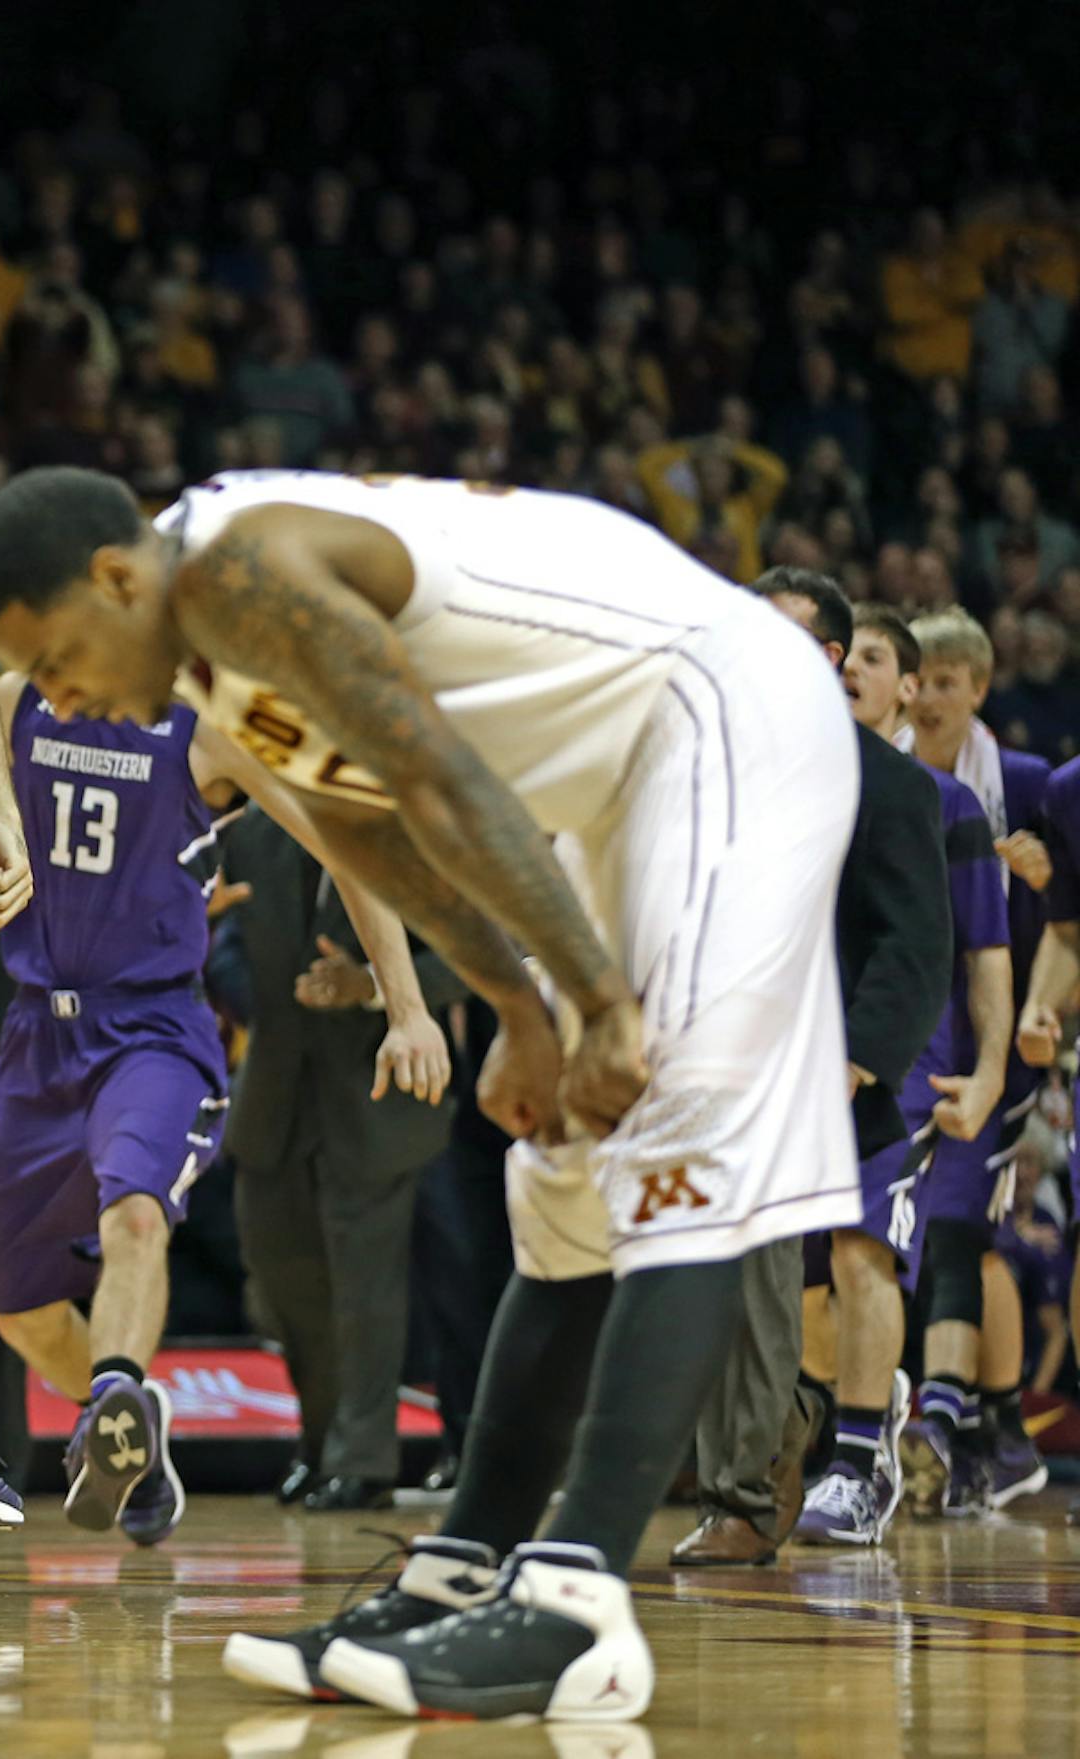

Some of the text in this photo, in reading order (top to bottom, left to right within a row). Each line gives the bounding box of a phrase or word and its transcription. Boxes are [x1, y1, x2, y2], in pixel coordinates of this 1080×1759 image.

[30, 736, 154, 783] NORTHWESTERN
[49, 780, 119, 875] 13
[632, 1164, 711, 1224] M
